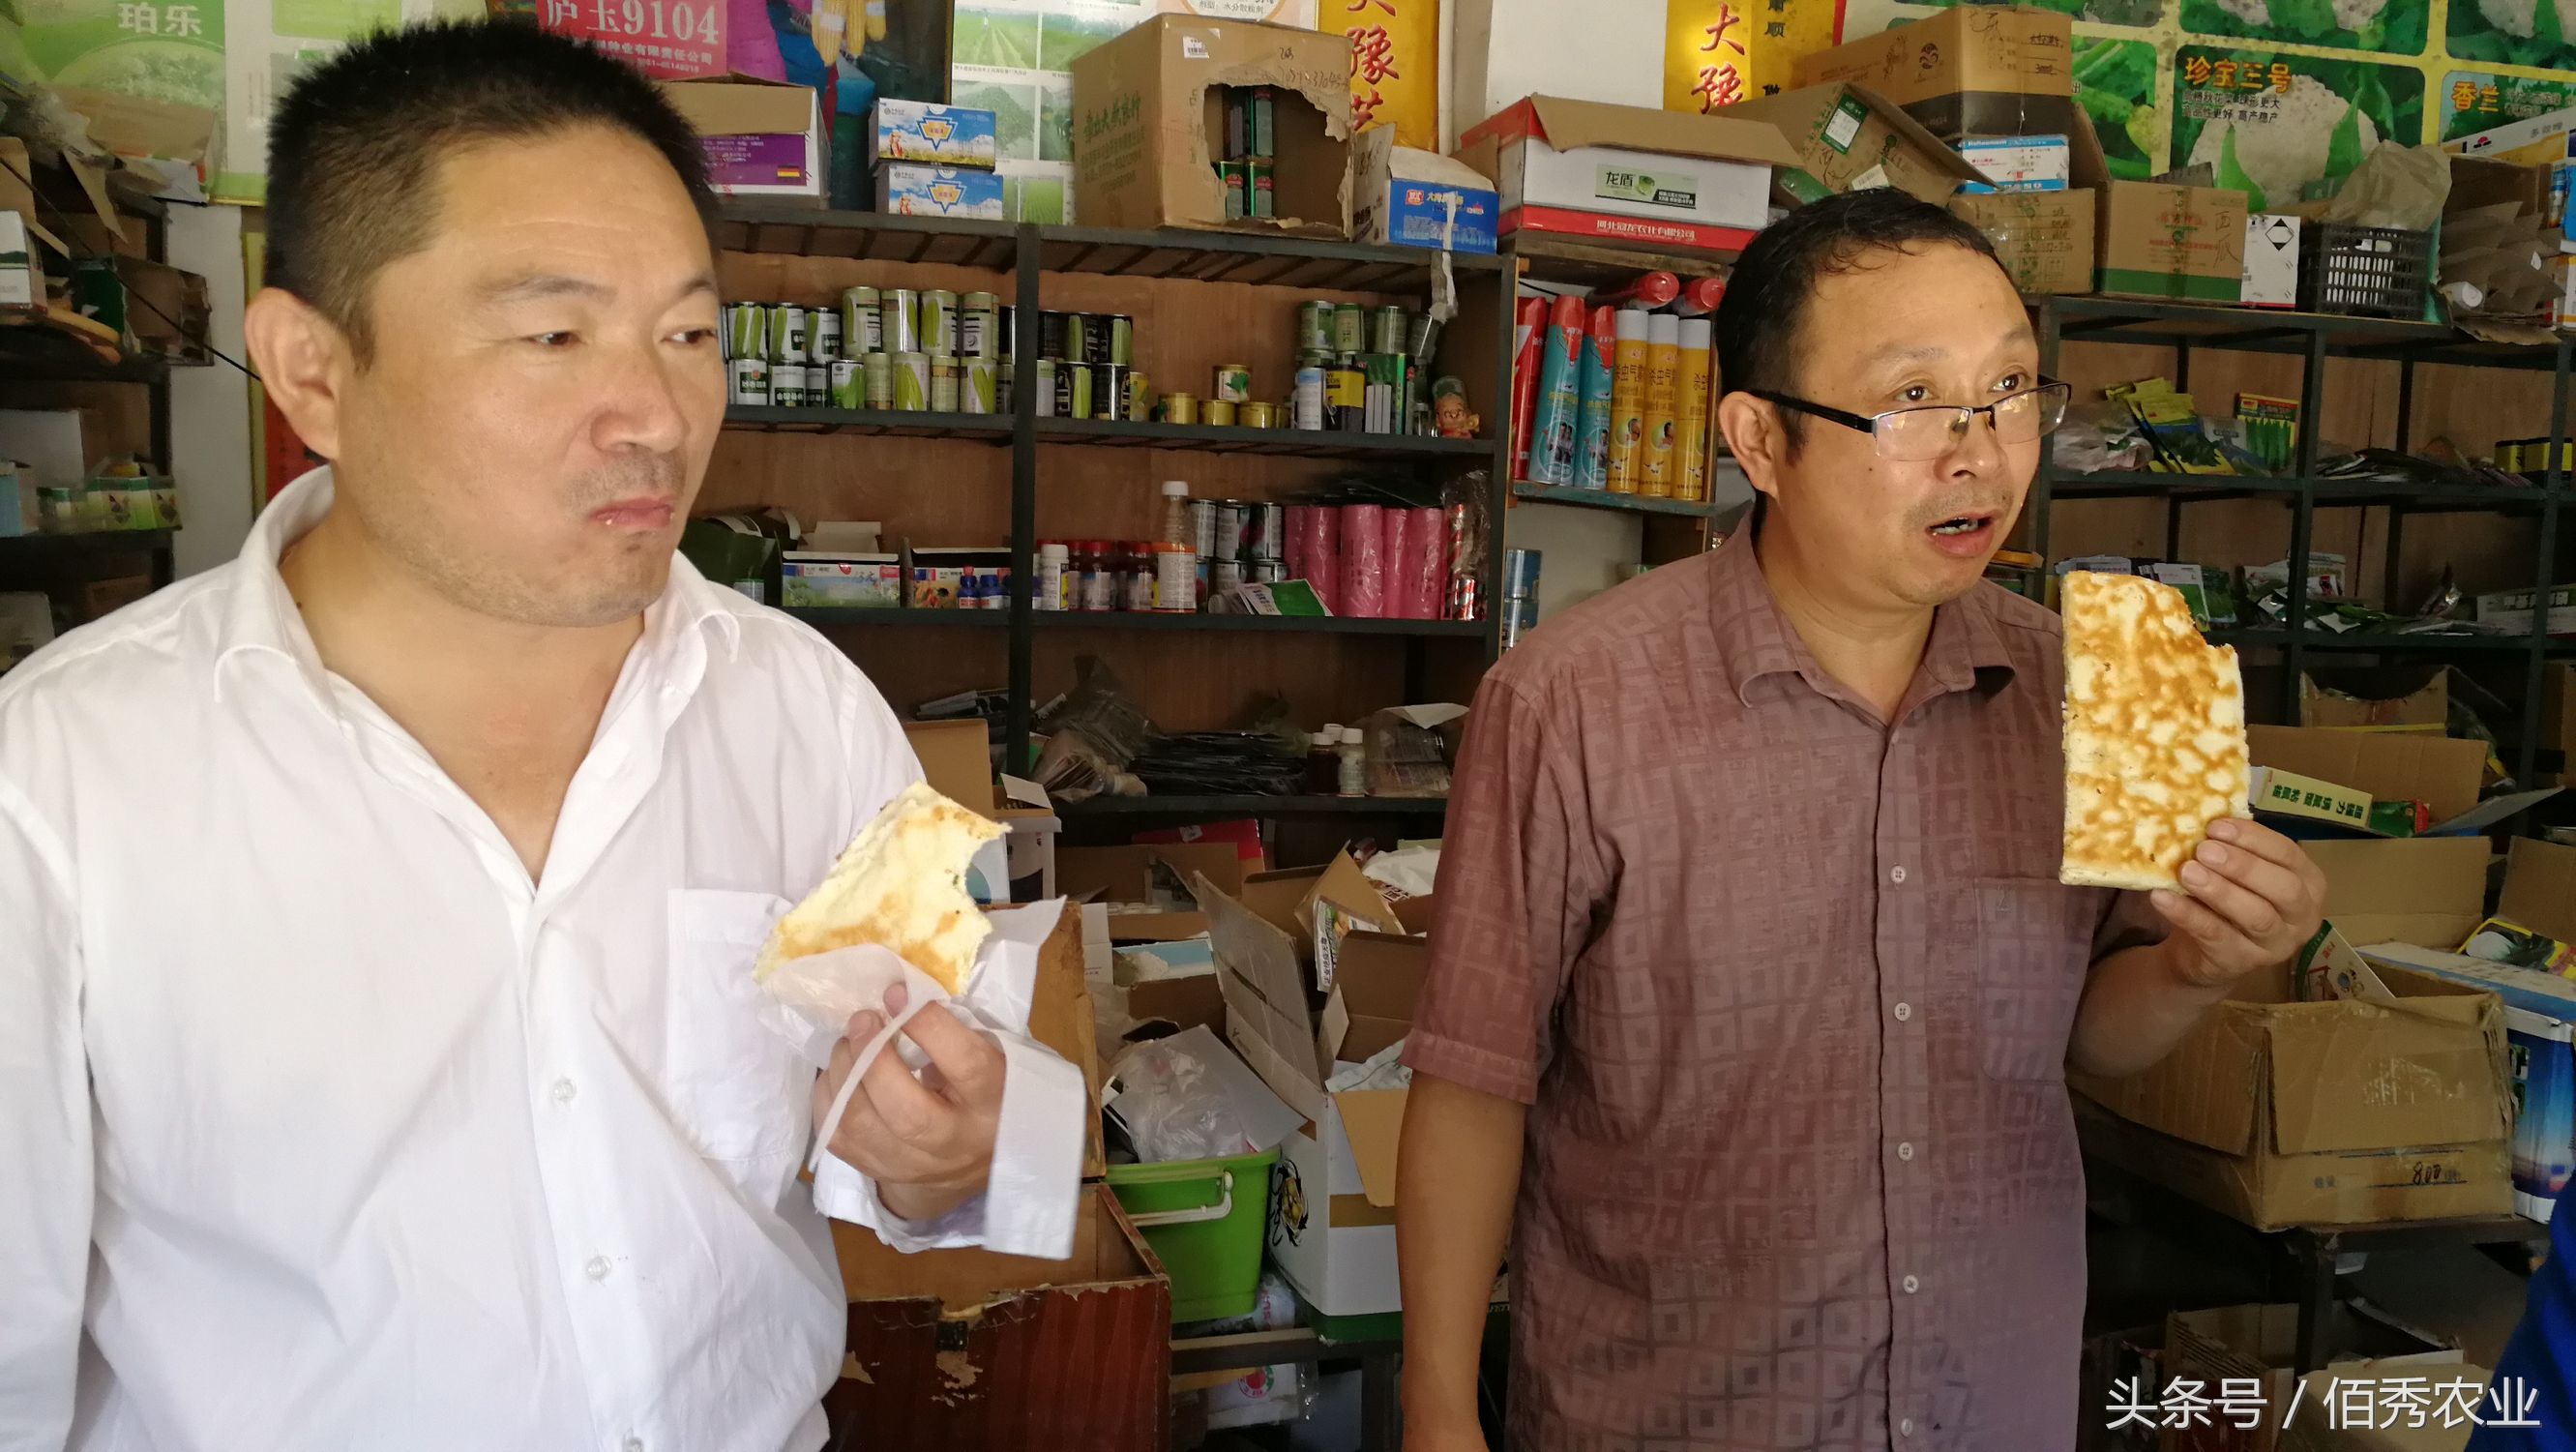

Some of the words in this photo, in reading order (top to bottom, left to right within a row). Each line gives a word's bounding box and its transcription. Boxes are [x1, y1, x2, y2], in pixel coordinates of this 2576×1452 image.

[117, 2, 203, 37] 珀乐
[2183, 55, 2293, 94] 珍宝三号
[2451, 80, 2501, 113] 香兰
[1606, 171, 1635, 188] 龙盾
